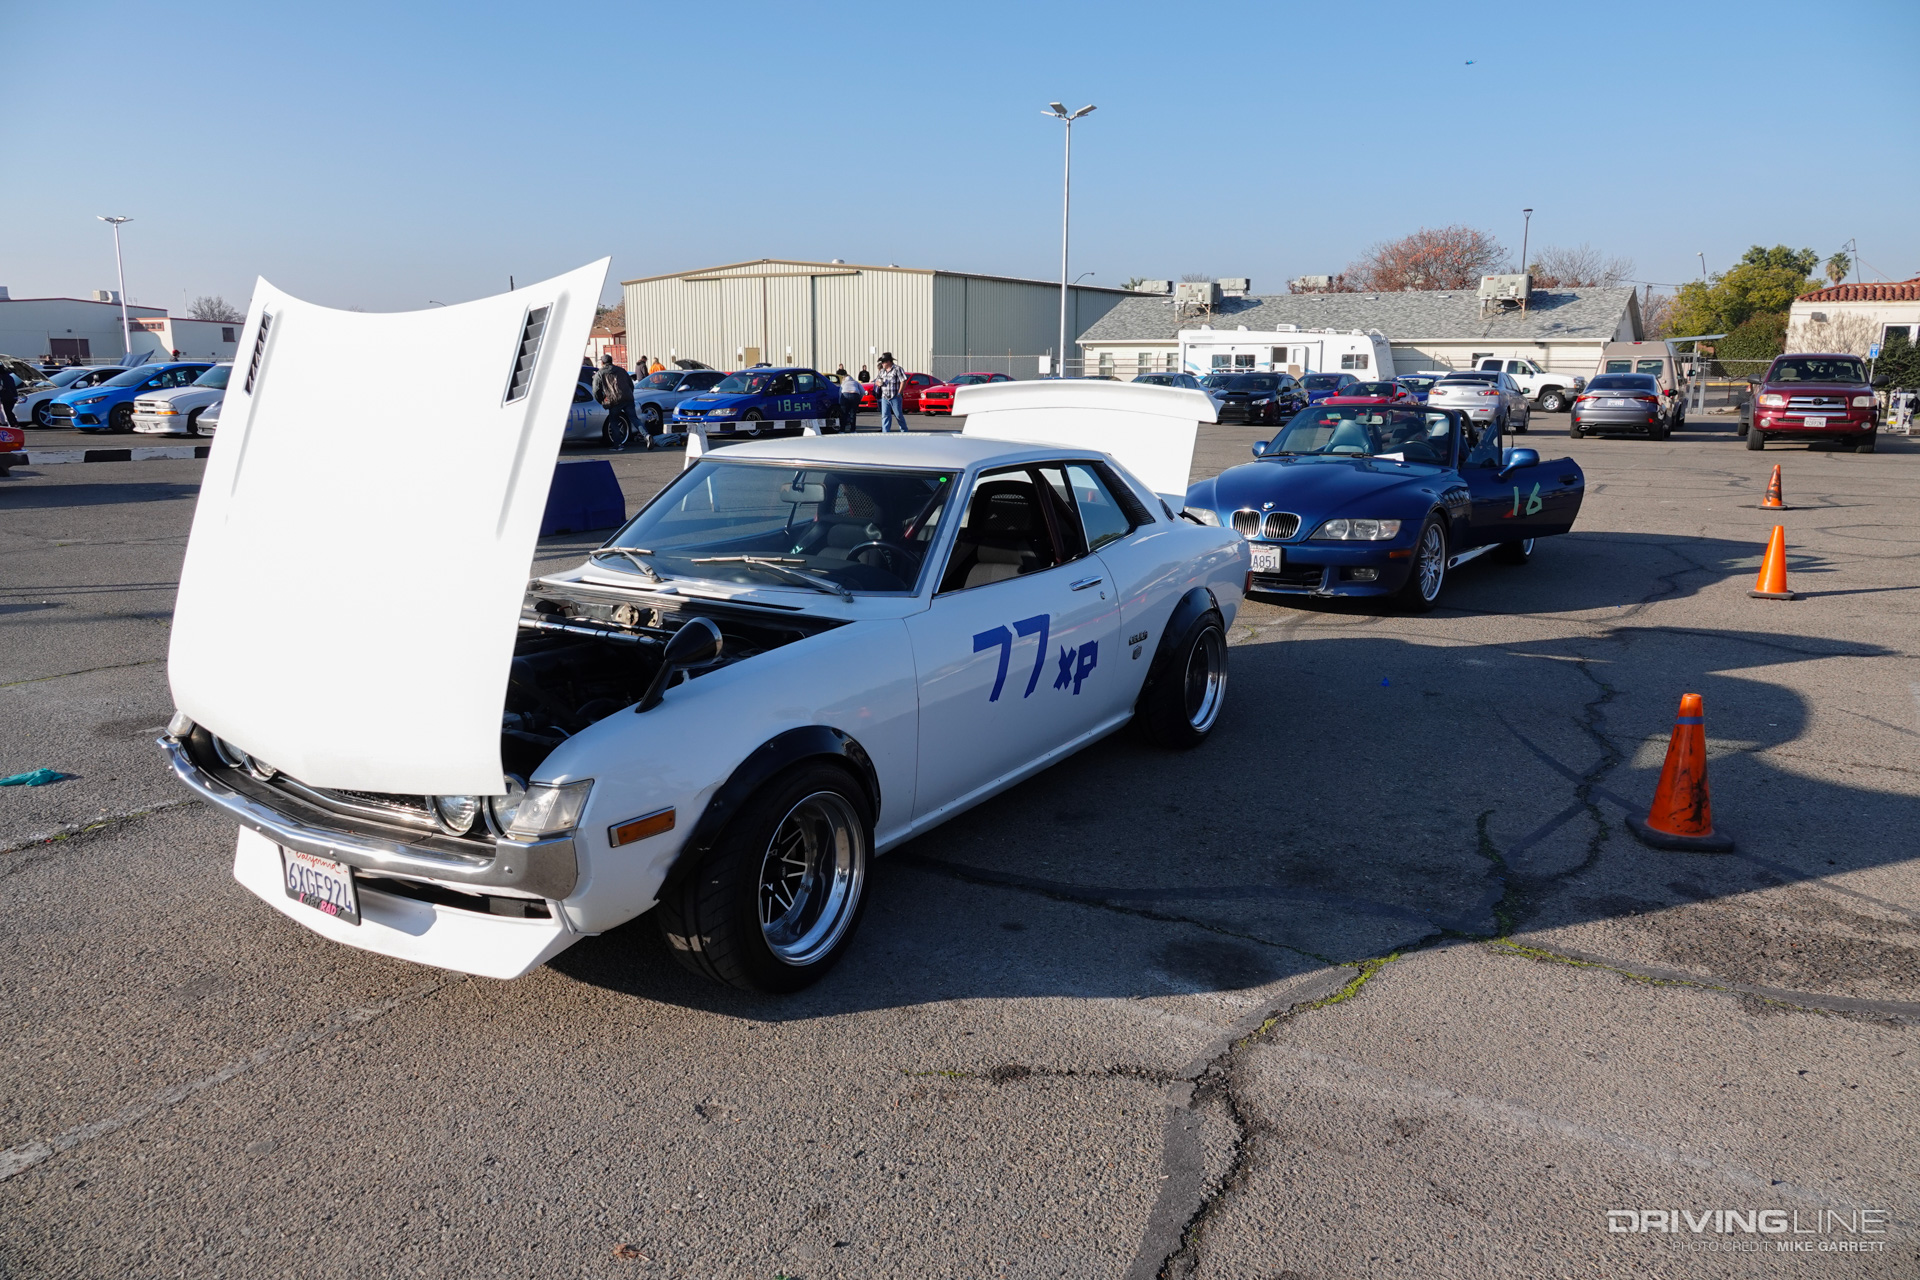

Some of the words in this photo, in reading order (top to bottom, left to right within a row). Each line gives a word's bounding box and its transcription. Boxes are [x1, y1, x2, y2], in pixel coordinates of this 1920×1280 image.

[777, 399, 791, 412] 18
[794, 402, 811, 412] SM
[1512, 482, 1542, 517] 16
[1252, 554, 1278, 569] A851
[972, 614, 1050, 702] 77
[1053, 640, 1099, 695] XP
